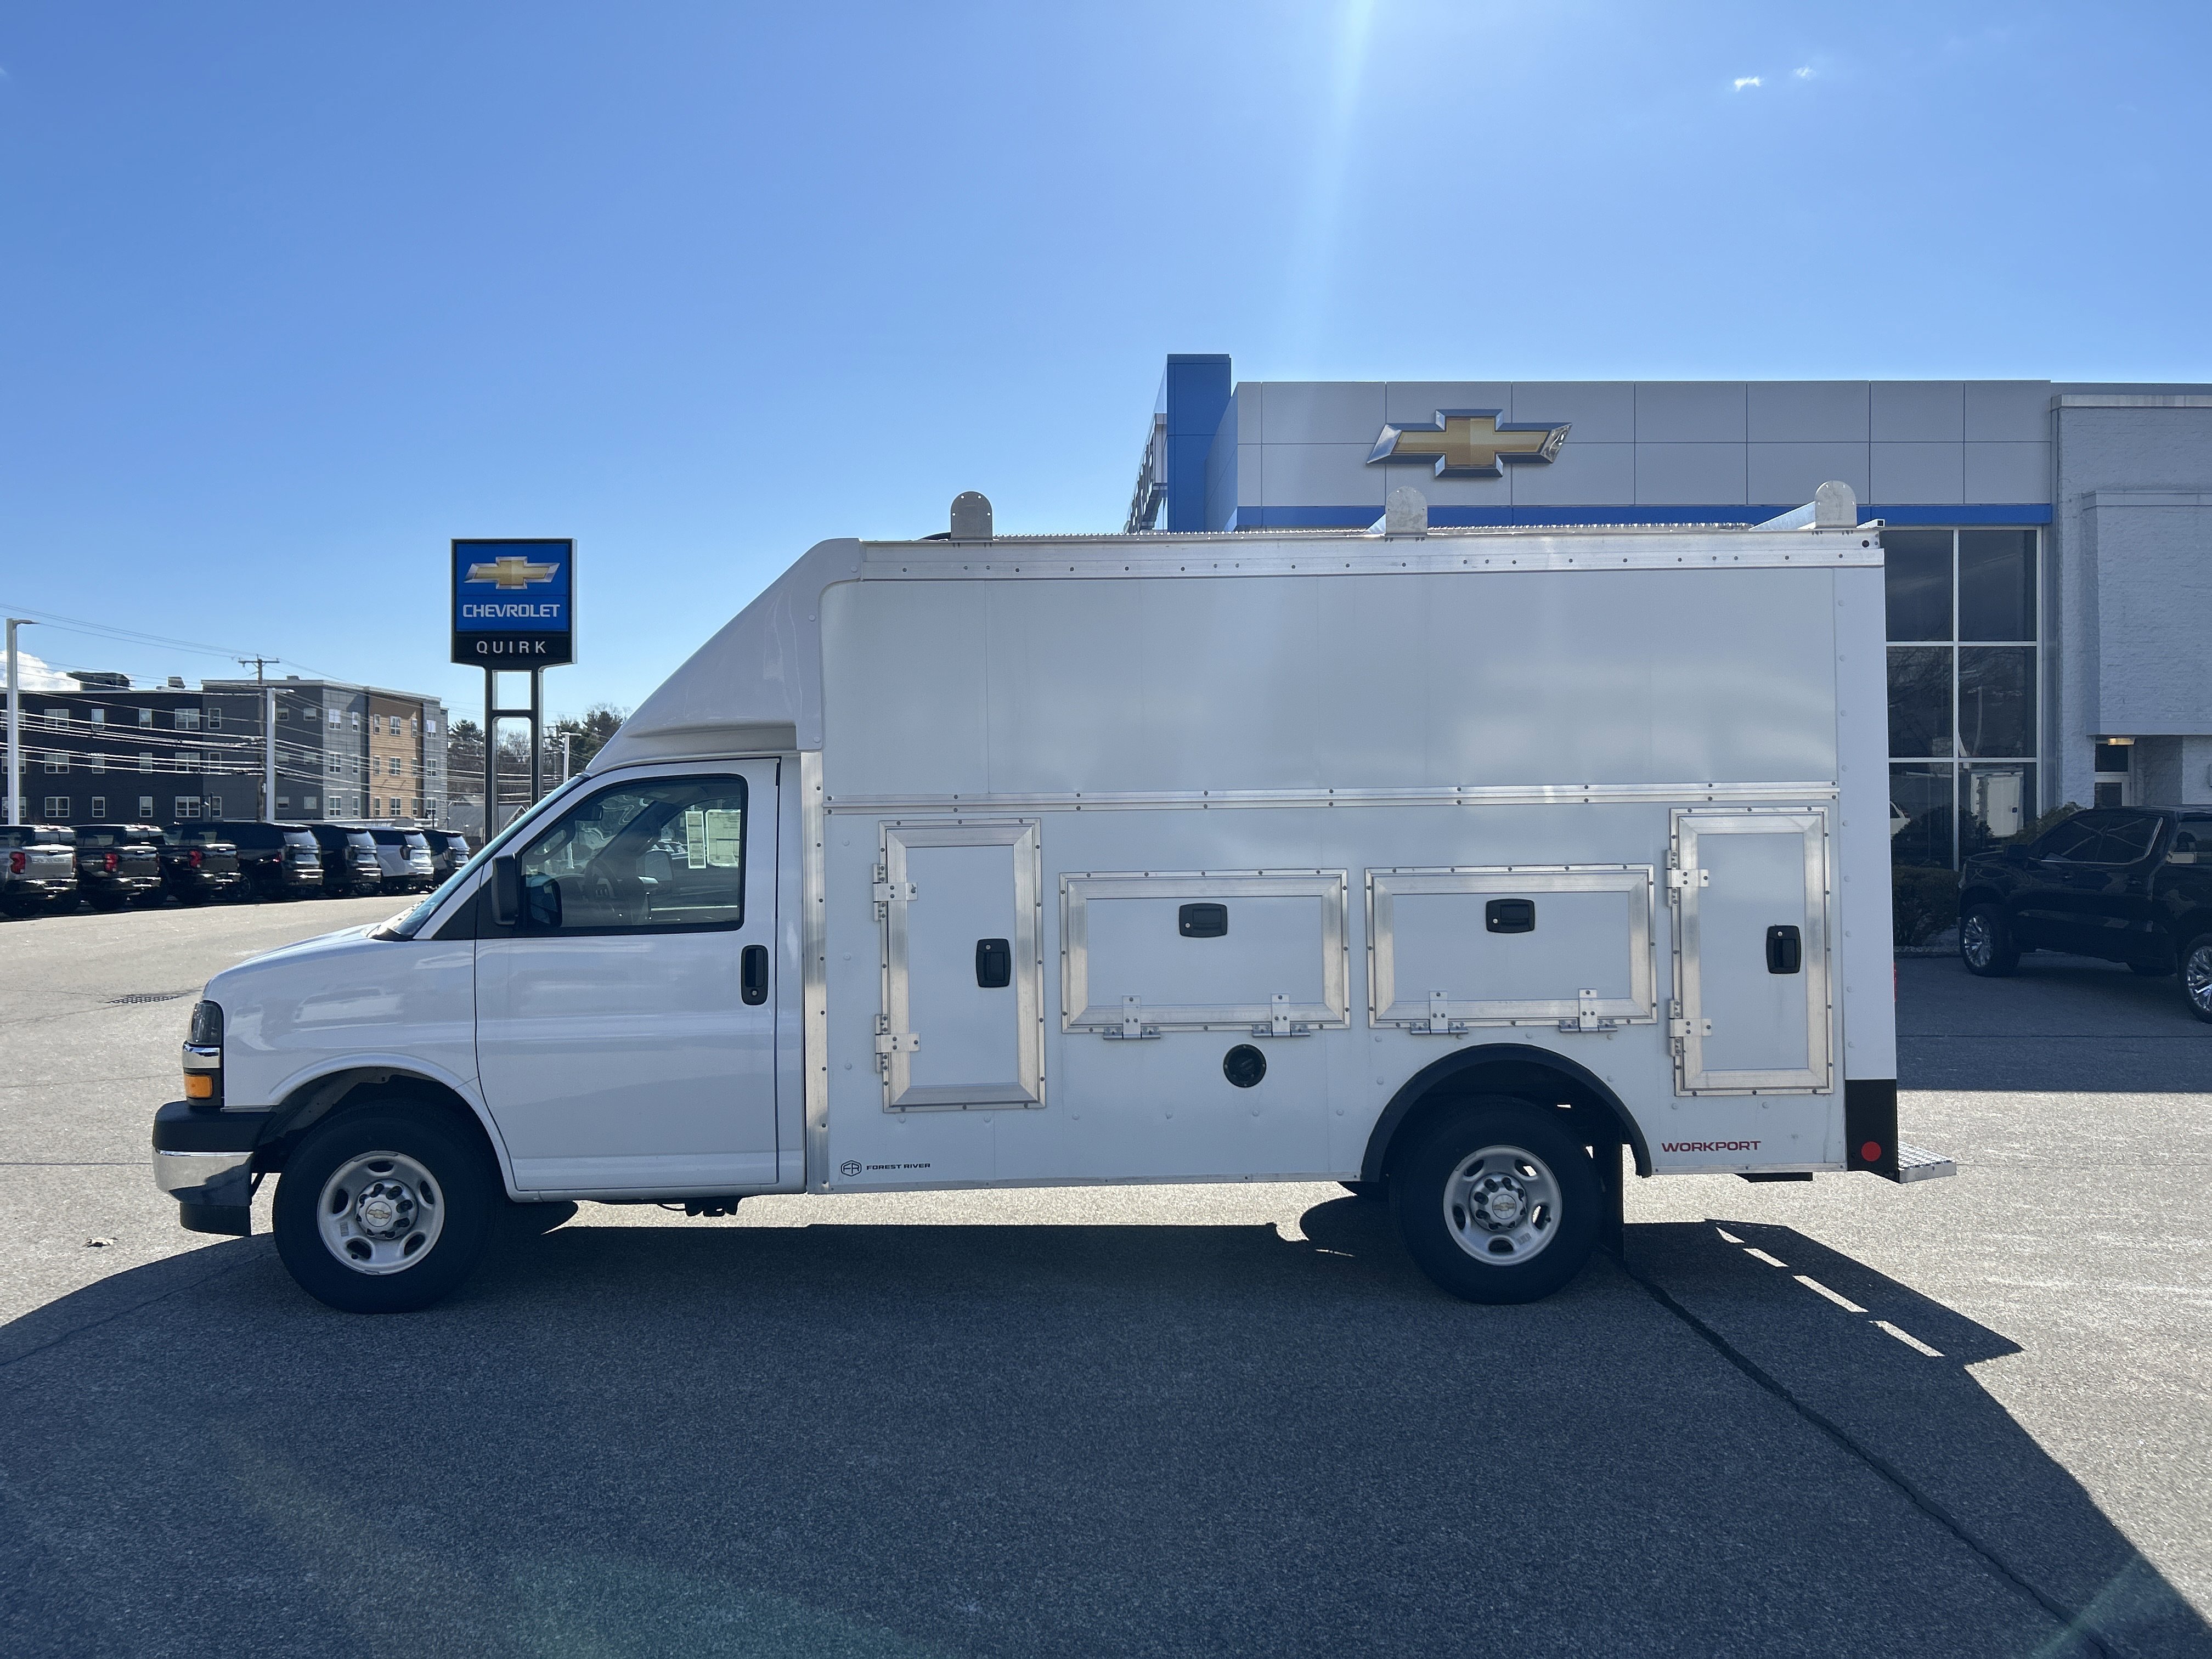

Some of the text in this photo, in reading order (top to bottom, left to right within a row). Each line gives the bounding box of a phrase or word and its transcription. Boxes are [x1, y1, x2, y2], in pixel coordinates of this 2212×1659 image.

[462, 604, 561, 618] CHEVROLET
[476, 640, 546, 654] QUIRK
[1661, 1141, 1762, 1153] WORKPORT
